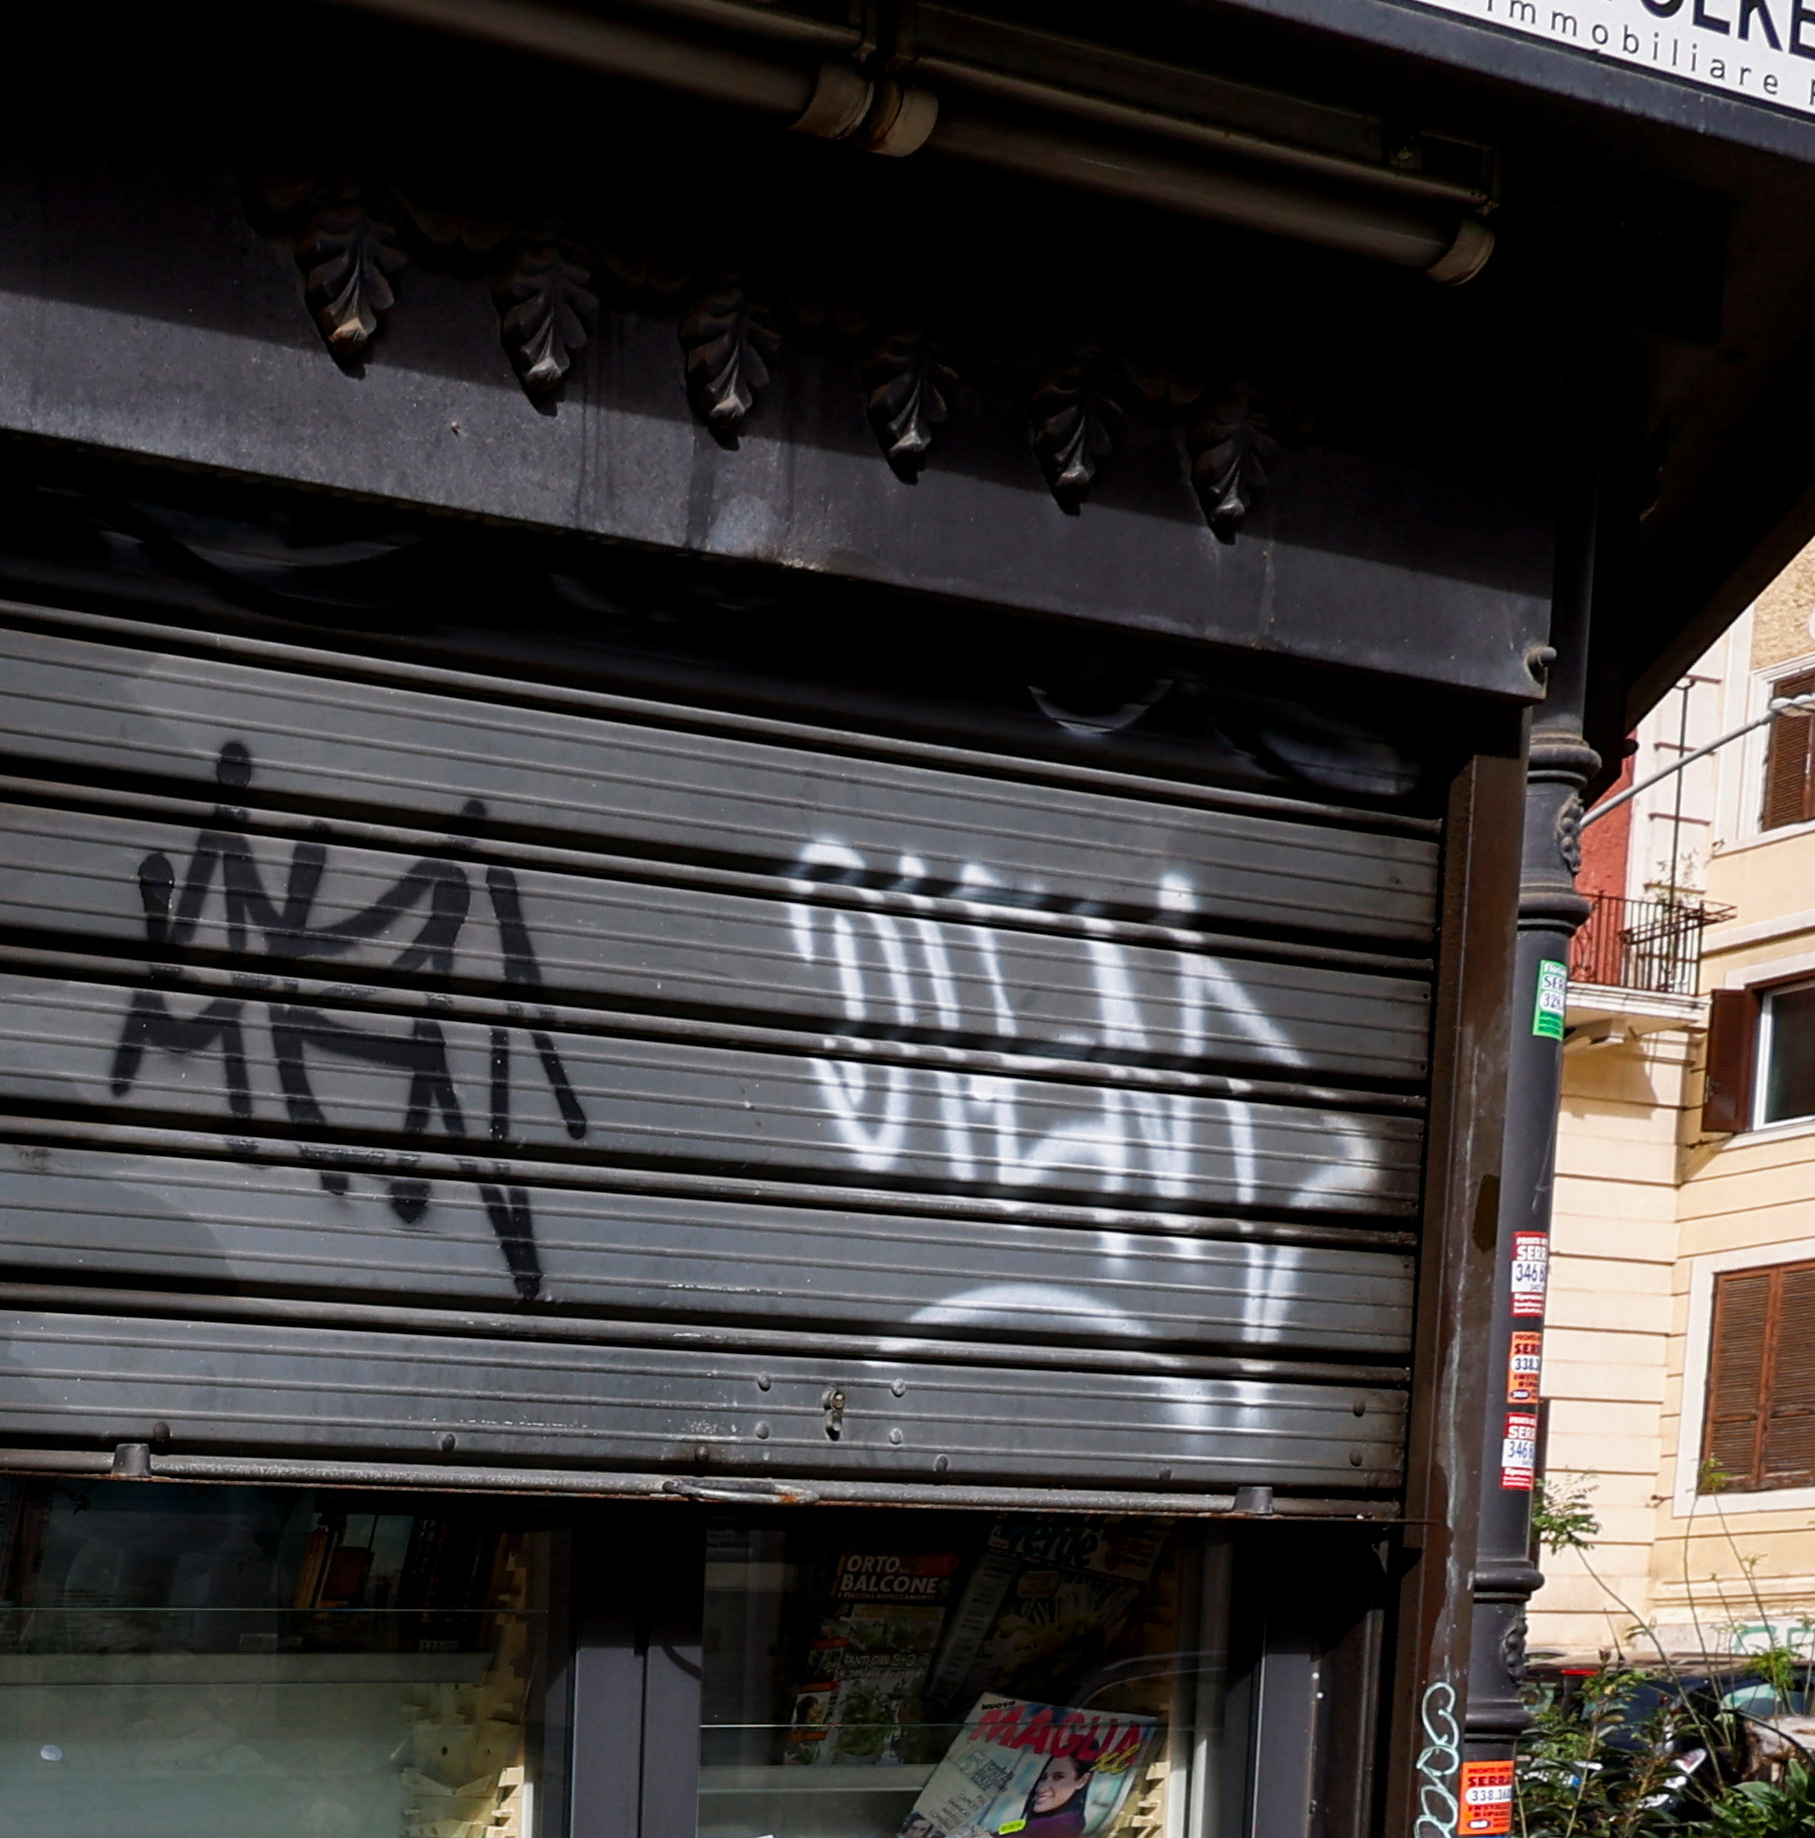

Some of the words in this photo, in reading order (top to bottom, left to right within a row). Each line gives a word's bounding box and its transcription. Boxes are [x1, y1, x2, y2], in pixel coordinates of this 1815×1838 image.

[846, 1555, 900, 1573] ORTO
[839, 1574, 938, 1595] BALCONE
[966, 1704, 1145, 1765] MAGLIA
